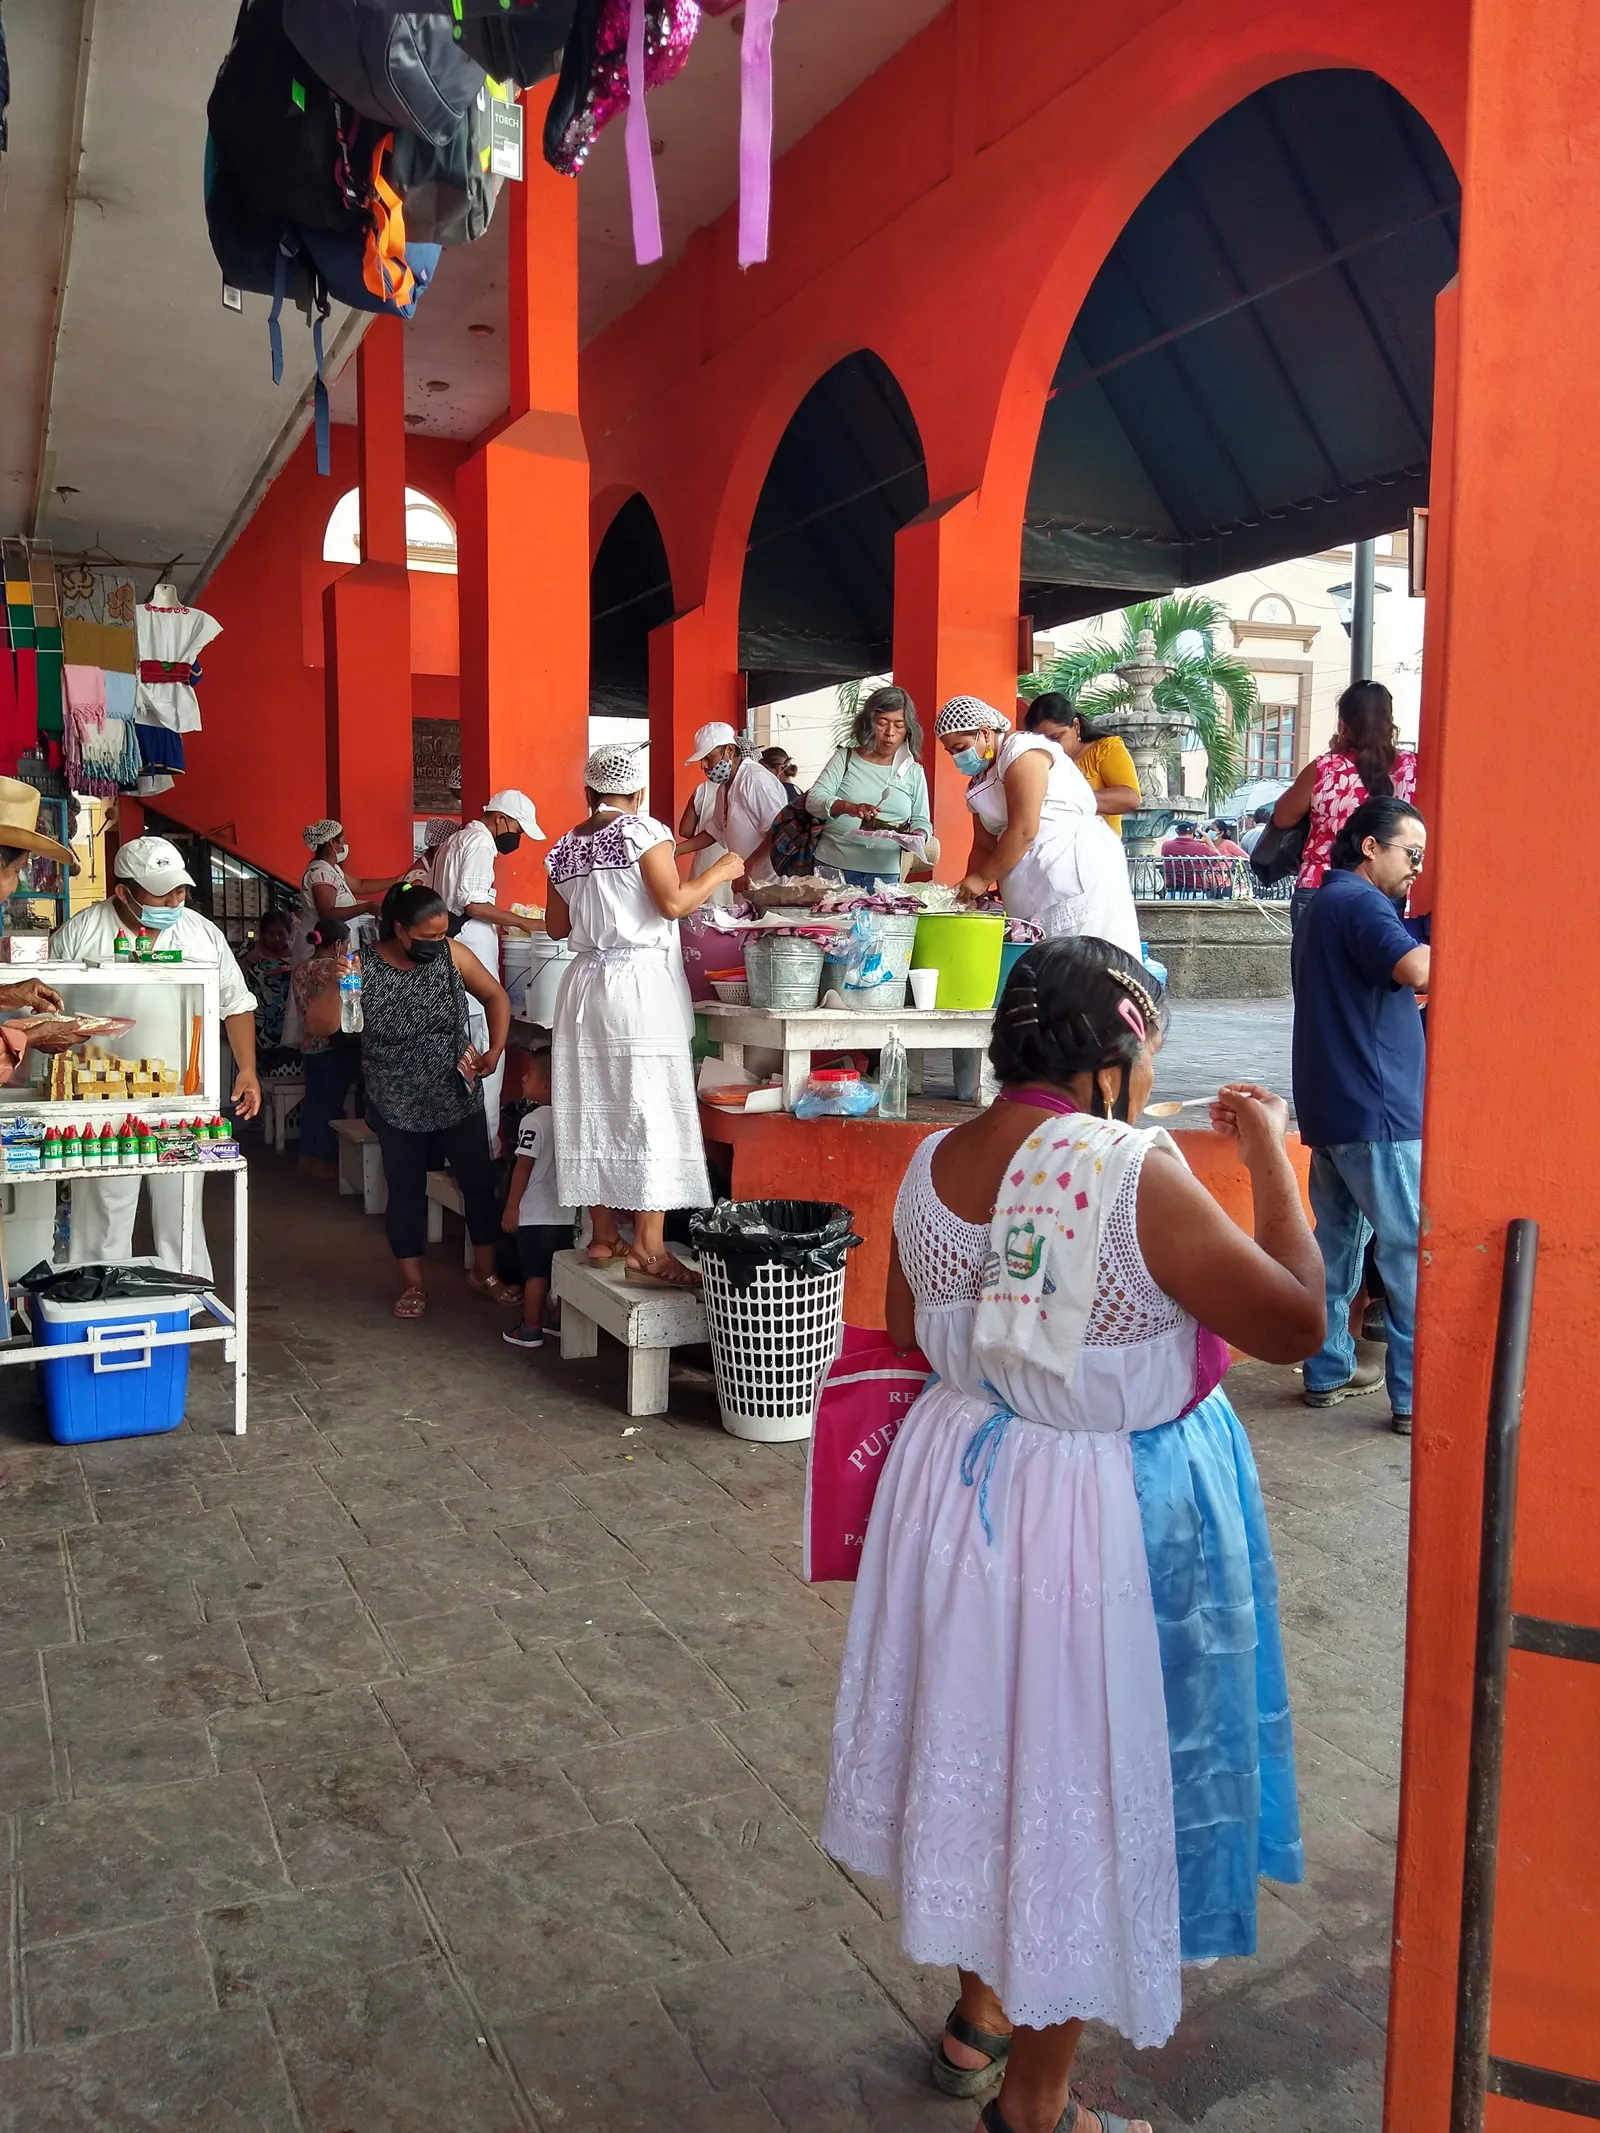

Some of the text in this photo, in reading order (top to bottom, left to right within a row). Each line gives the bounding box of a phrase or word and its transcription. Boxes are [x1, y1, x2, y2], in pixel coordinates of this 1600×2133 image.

[494, 113, 519, 129] TORCH
[416, 766, 449, 778] MIGUEL
[212, 1145, 237, 1153] HALLS
